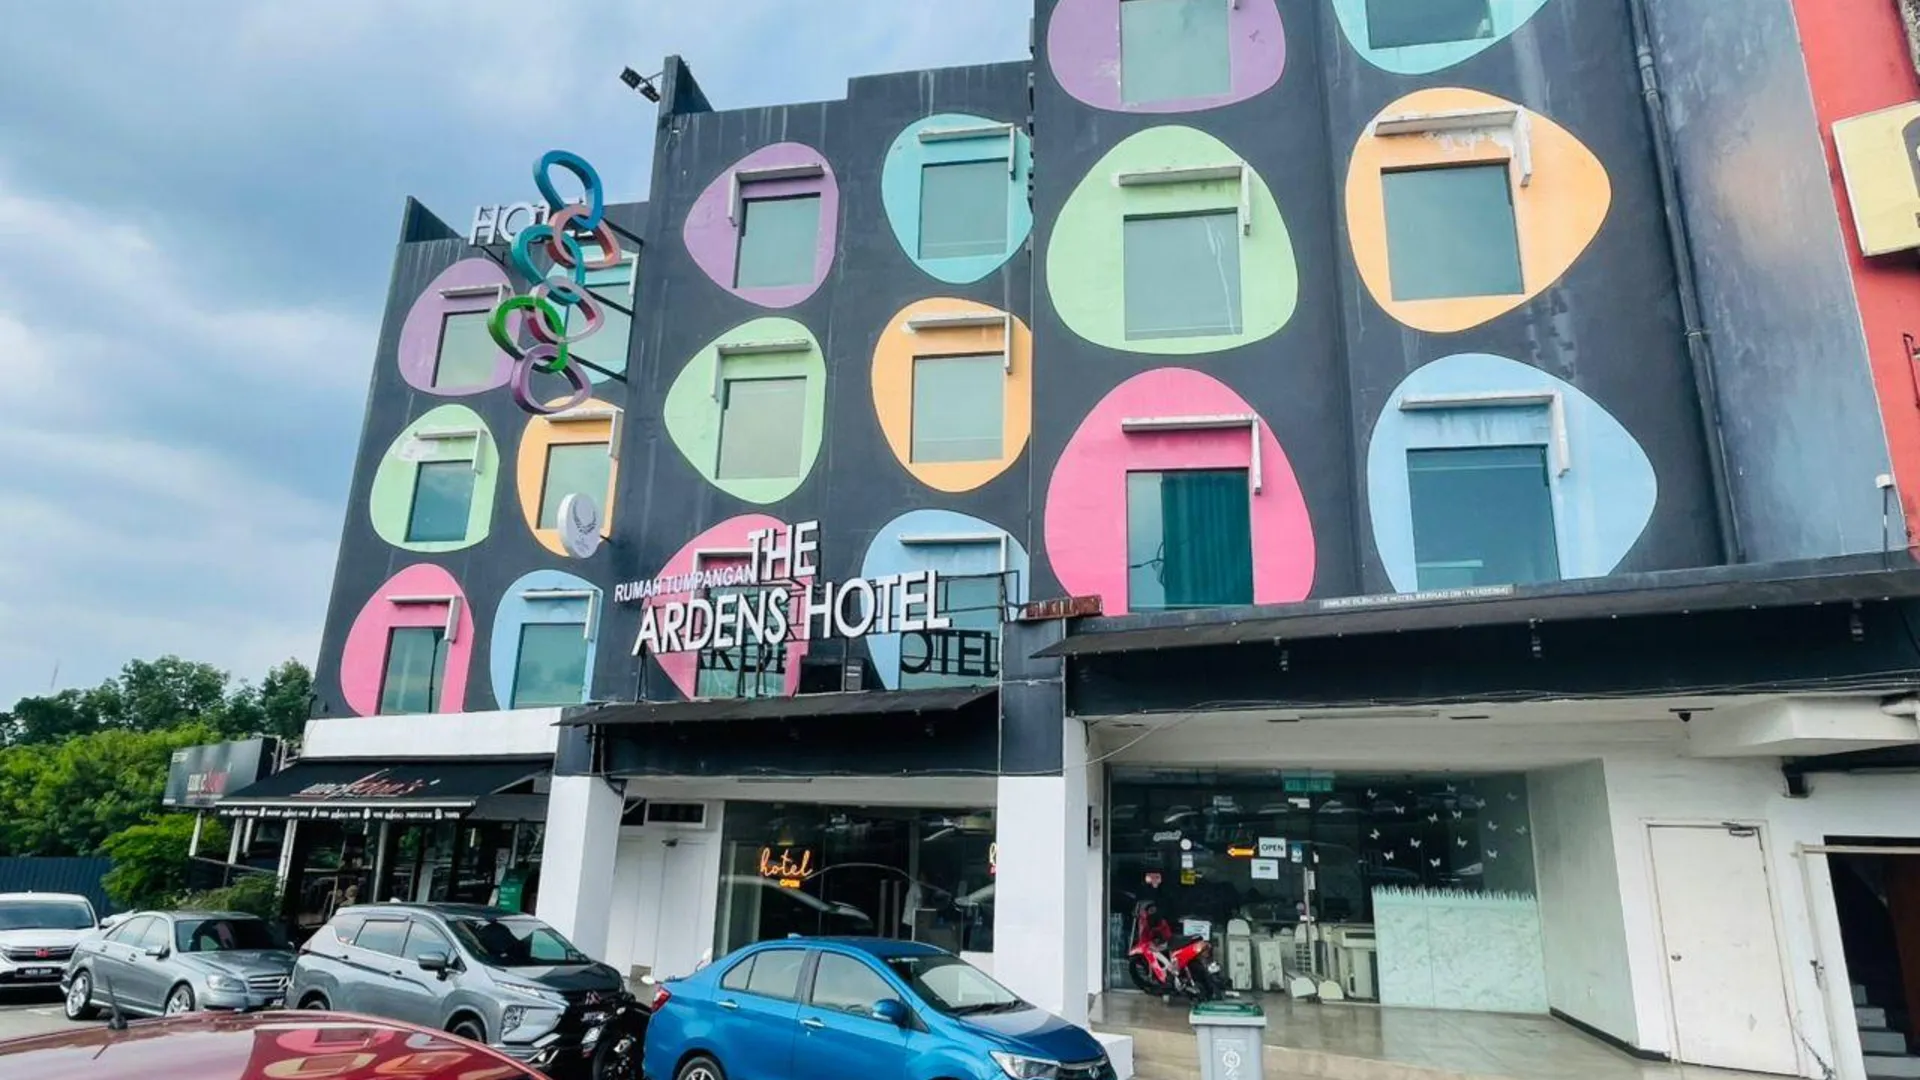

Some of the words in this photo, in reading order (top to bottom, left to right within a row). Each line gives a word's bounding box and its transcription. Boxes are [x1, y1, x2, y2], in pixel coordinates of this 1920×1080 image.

[747, 519, 819, 581] THE
[614, 576, 662, 603] RUMAH
[664, 563, 756, 594] TUMPANGAN
[632, 586, 789, 656] ARDENS
[804, 569, 952, 640] HOTEL
[760, 847, 813, 877] hotel
[1260, 843, 1285, 852] OPEN
